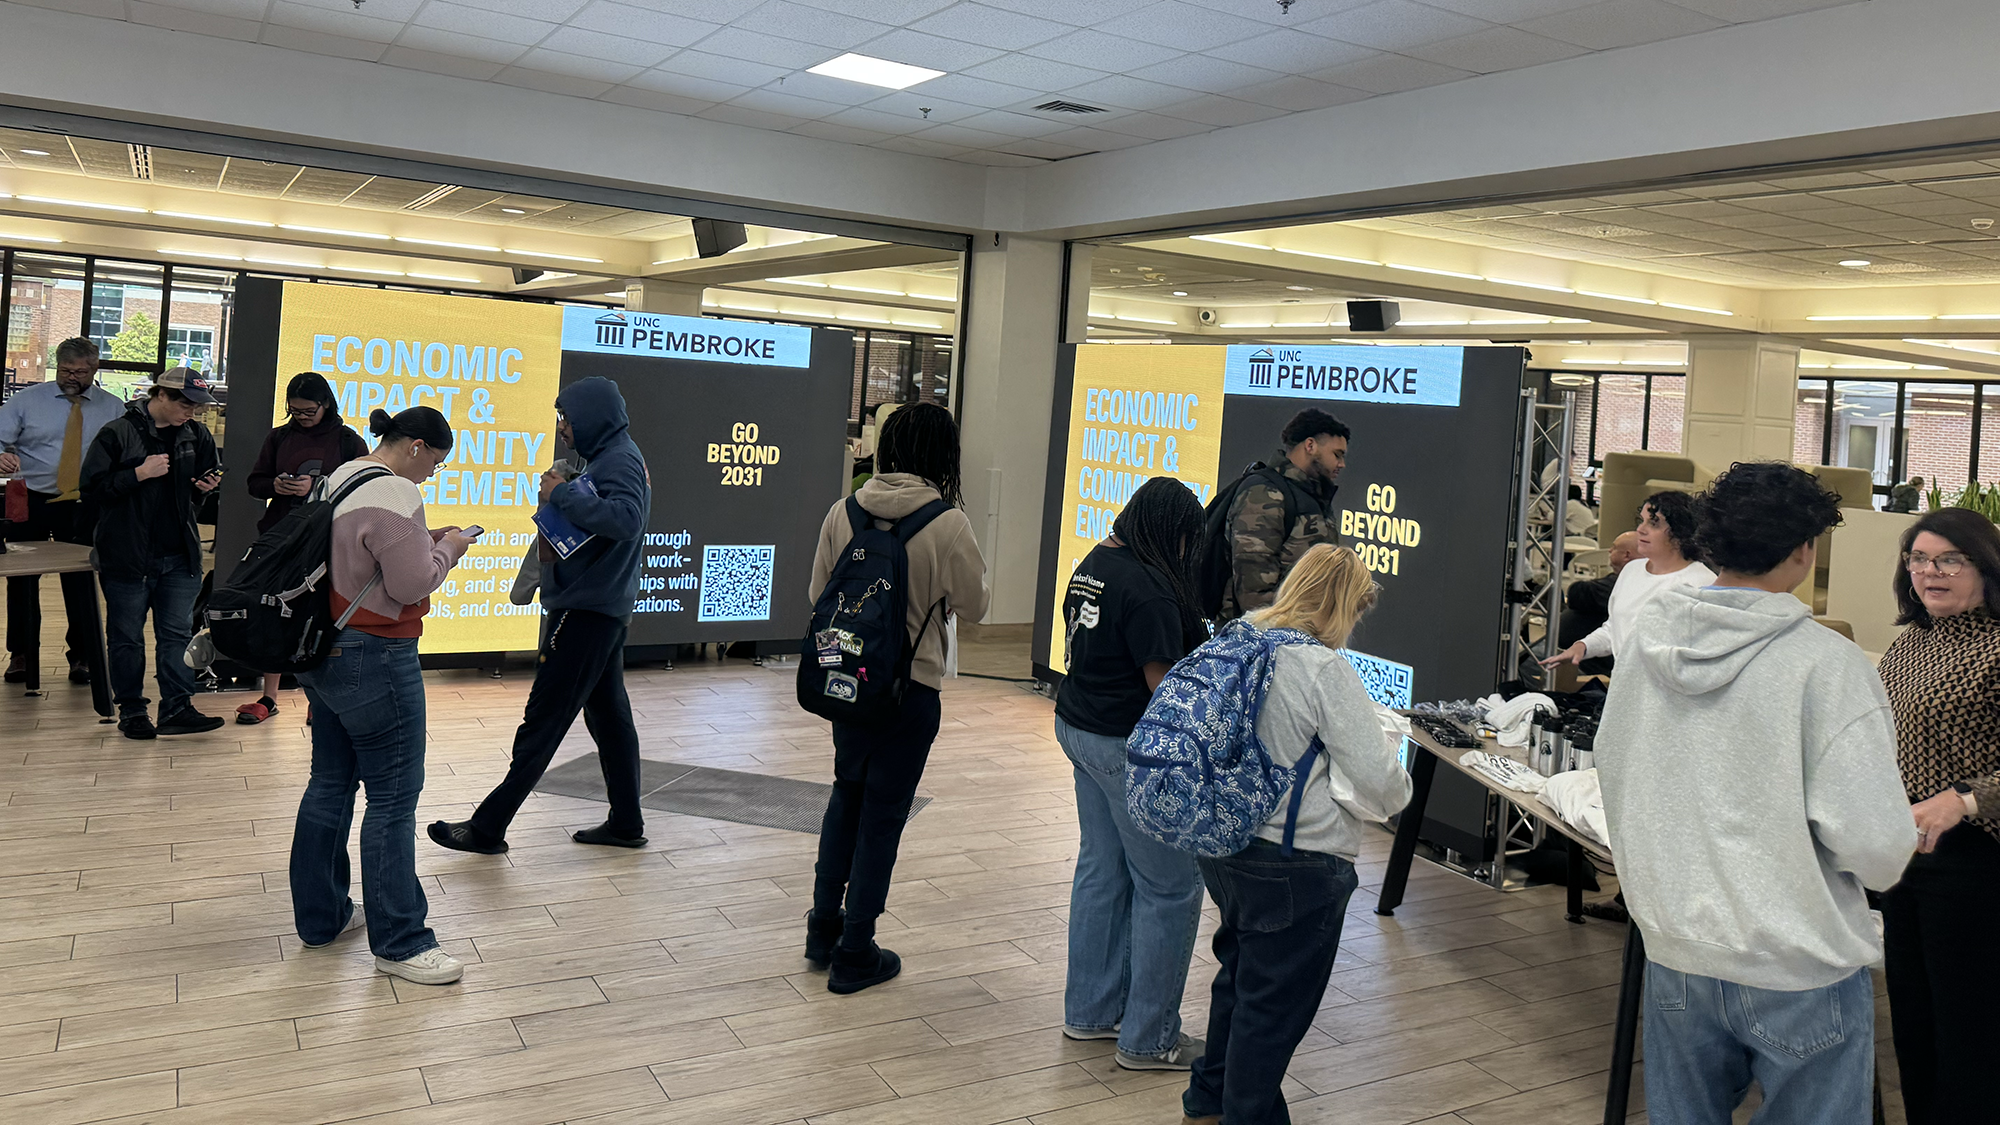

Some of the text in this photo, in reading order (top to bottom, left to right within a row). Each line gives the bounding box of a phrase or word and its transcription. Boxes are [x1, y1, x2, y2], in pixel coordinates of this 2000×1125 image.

[633, 316, 661, 328] UNC
[631, 328, 776, 360] PEMBROKE
[1278, 350, 1302, 363] UNC
[311, 333, 524, 384] ECONOMIC
[1276, 364, 1419, 395] PEMBROKE
[326, 379, 496, 424] MPACT &
[1085, 387, 1199, 431] ECONOMIC
[731, 421, 760, 444] GO
[706, 443, 781, 465] BEYOND
[1081, 427, 1180, 473] IMPACT &
[720, 465, 763, 487] 2031
[1366, 482, 1397, 514] GO
[642, 529, 693, 550] hrough
[1340, 509, 1421, 548] BEYOND
[646, 551, 692, 568] work-
[1354, 541, 1400, 576] 2031
[464, 575, 496, 594] and
[667, 572, 699, 590] with
[459, 599, 490, 618] and
